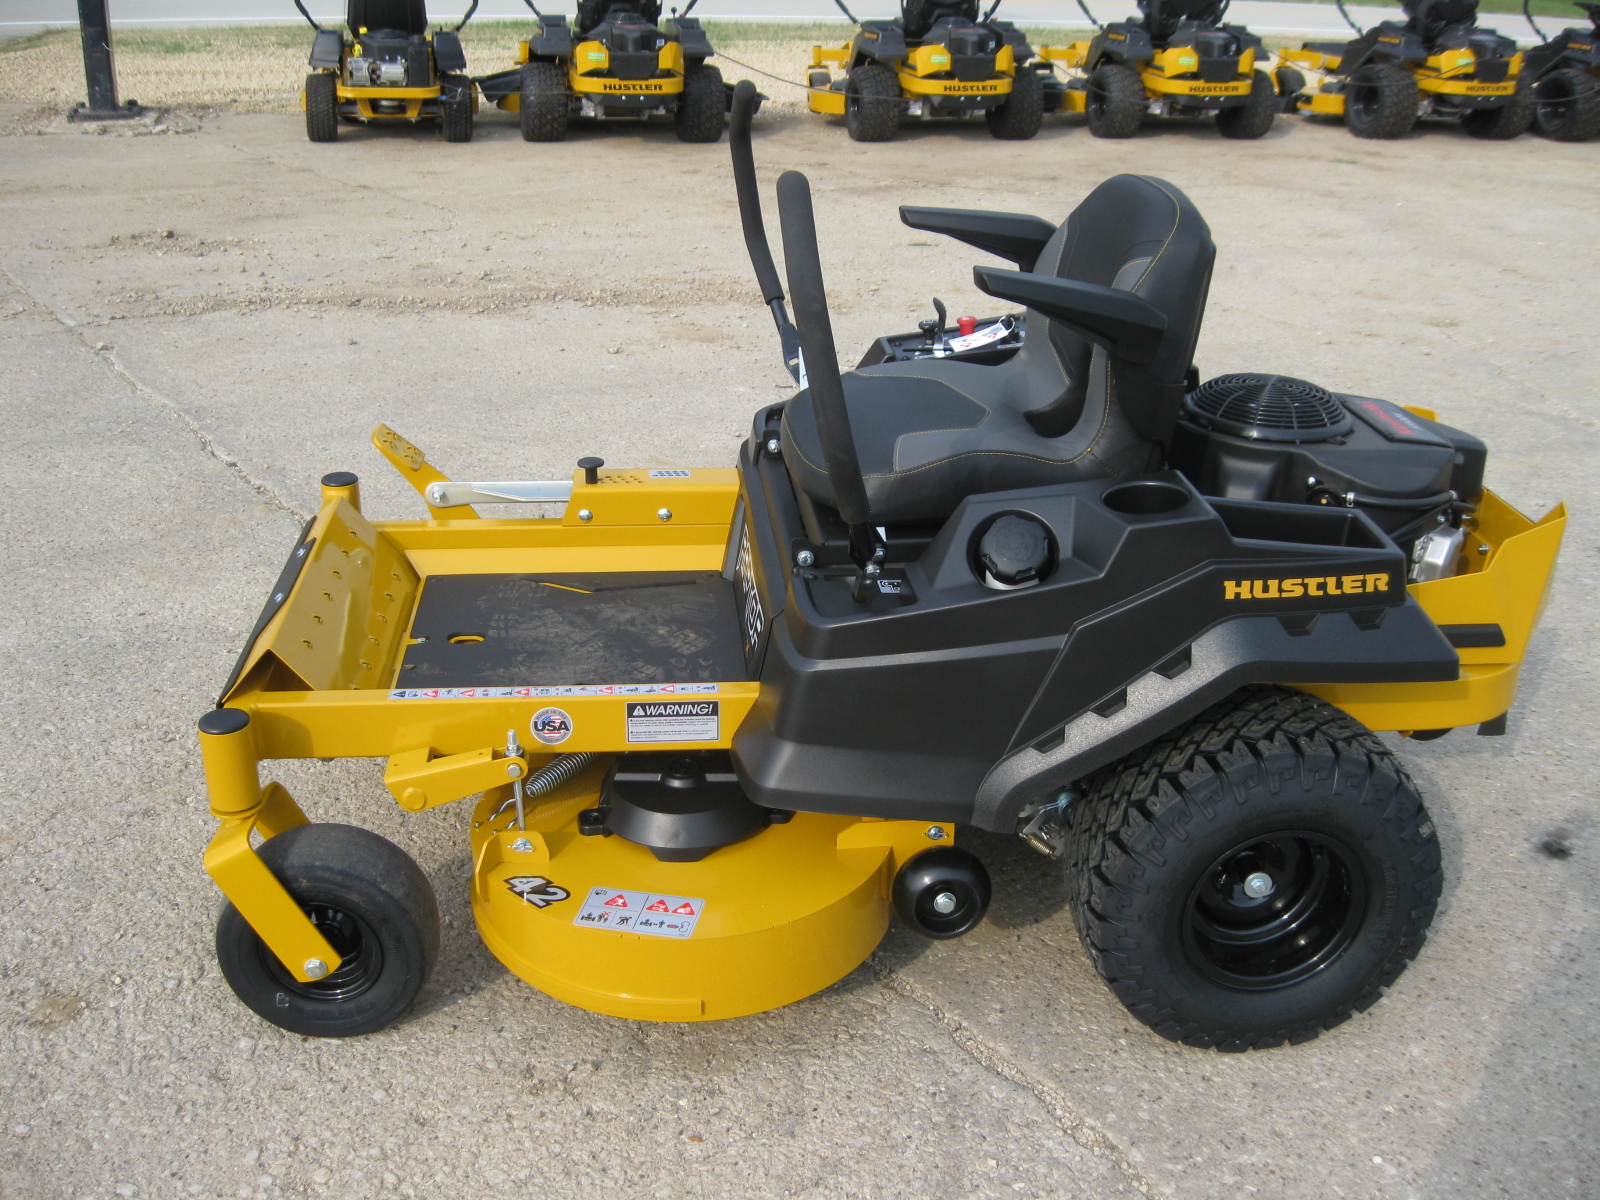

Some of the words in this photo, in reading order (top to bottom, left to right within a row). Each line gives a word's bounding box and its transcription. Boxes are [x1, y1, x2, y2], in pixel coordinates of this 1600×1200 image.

[603, 83, 663, 91] HUSTLER
[943, 84, 998, 92] HUSTLER
[1223, 572, 1390, 600] HUSTLER
[645, 703, 714, 716] WARNING!
[533, 720, 570, 732] USA
[503, 876, 572, 909] 42
